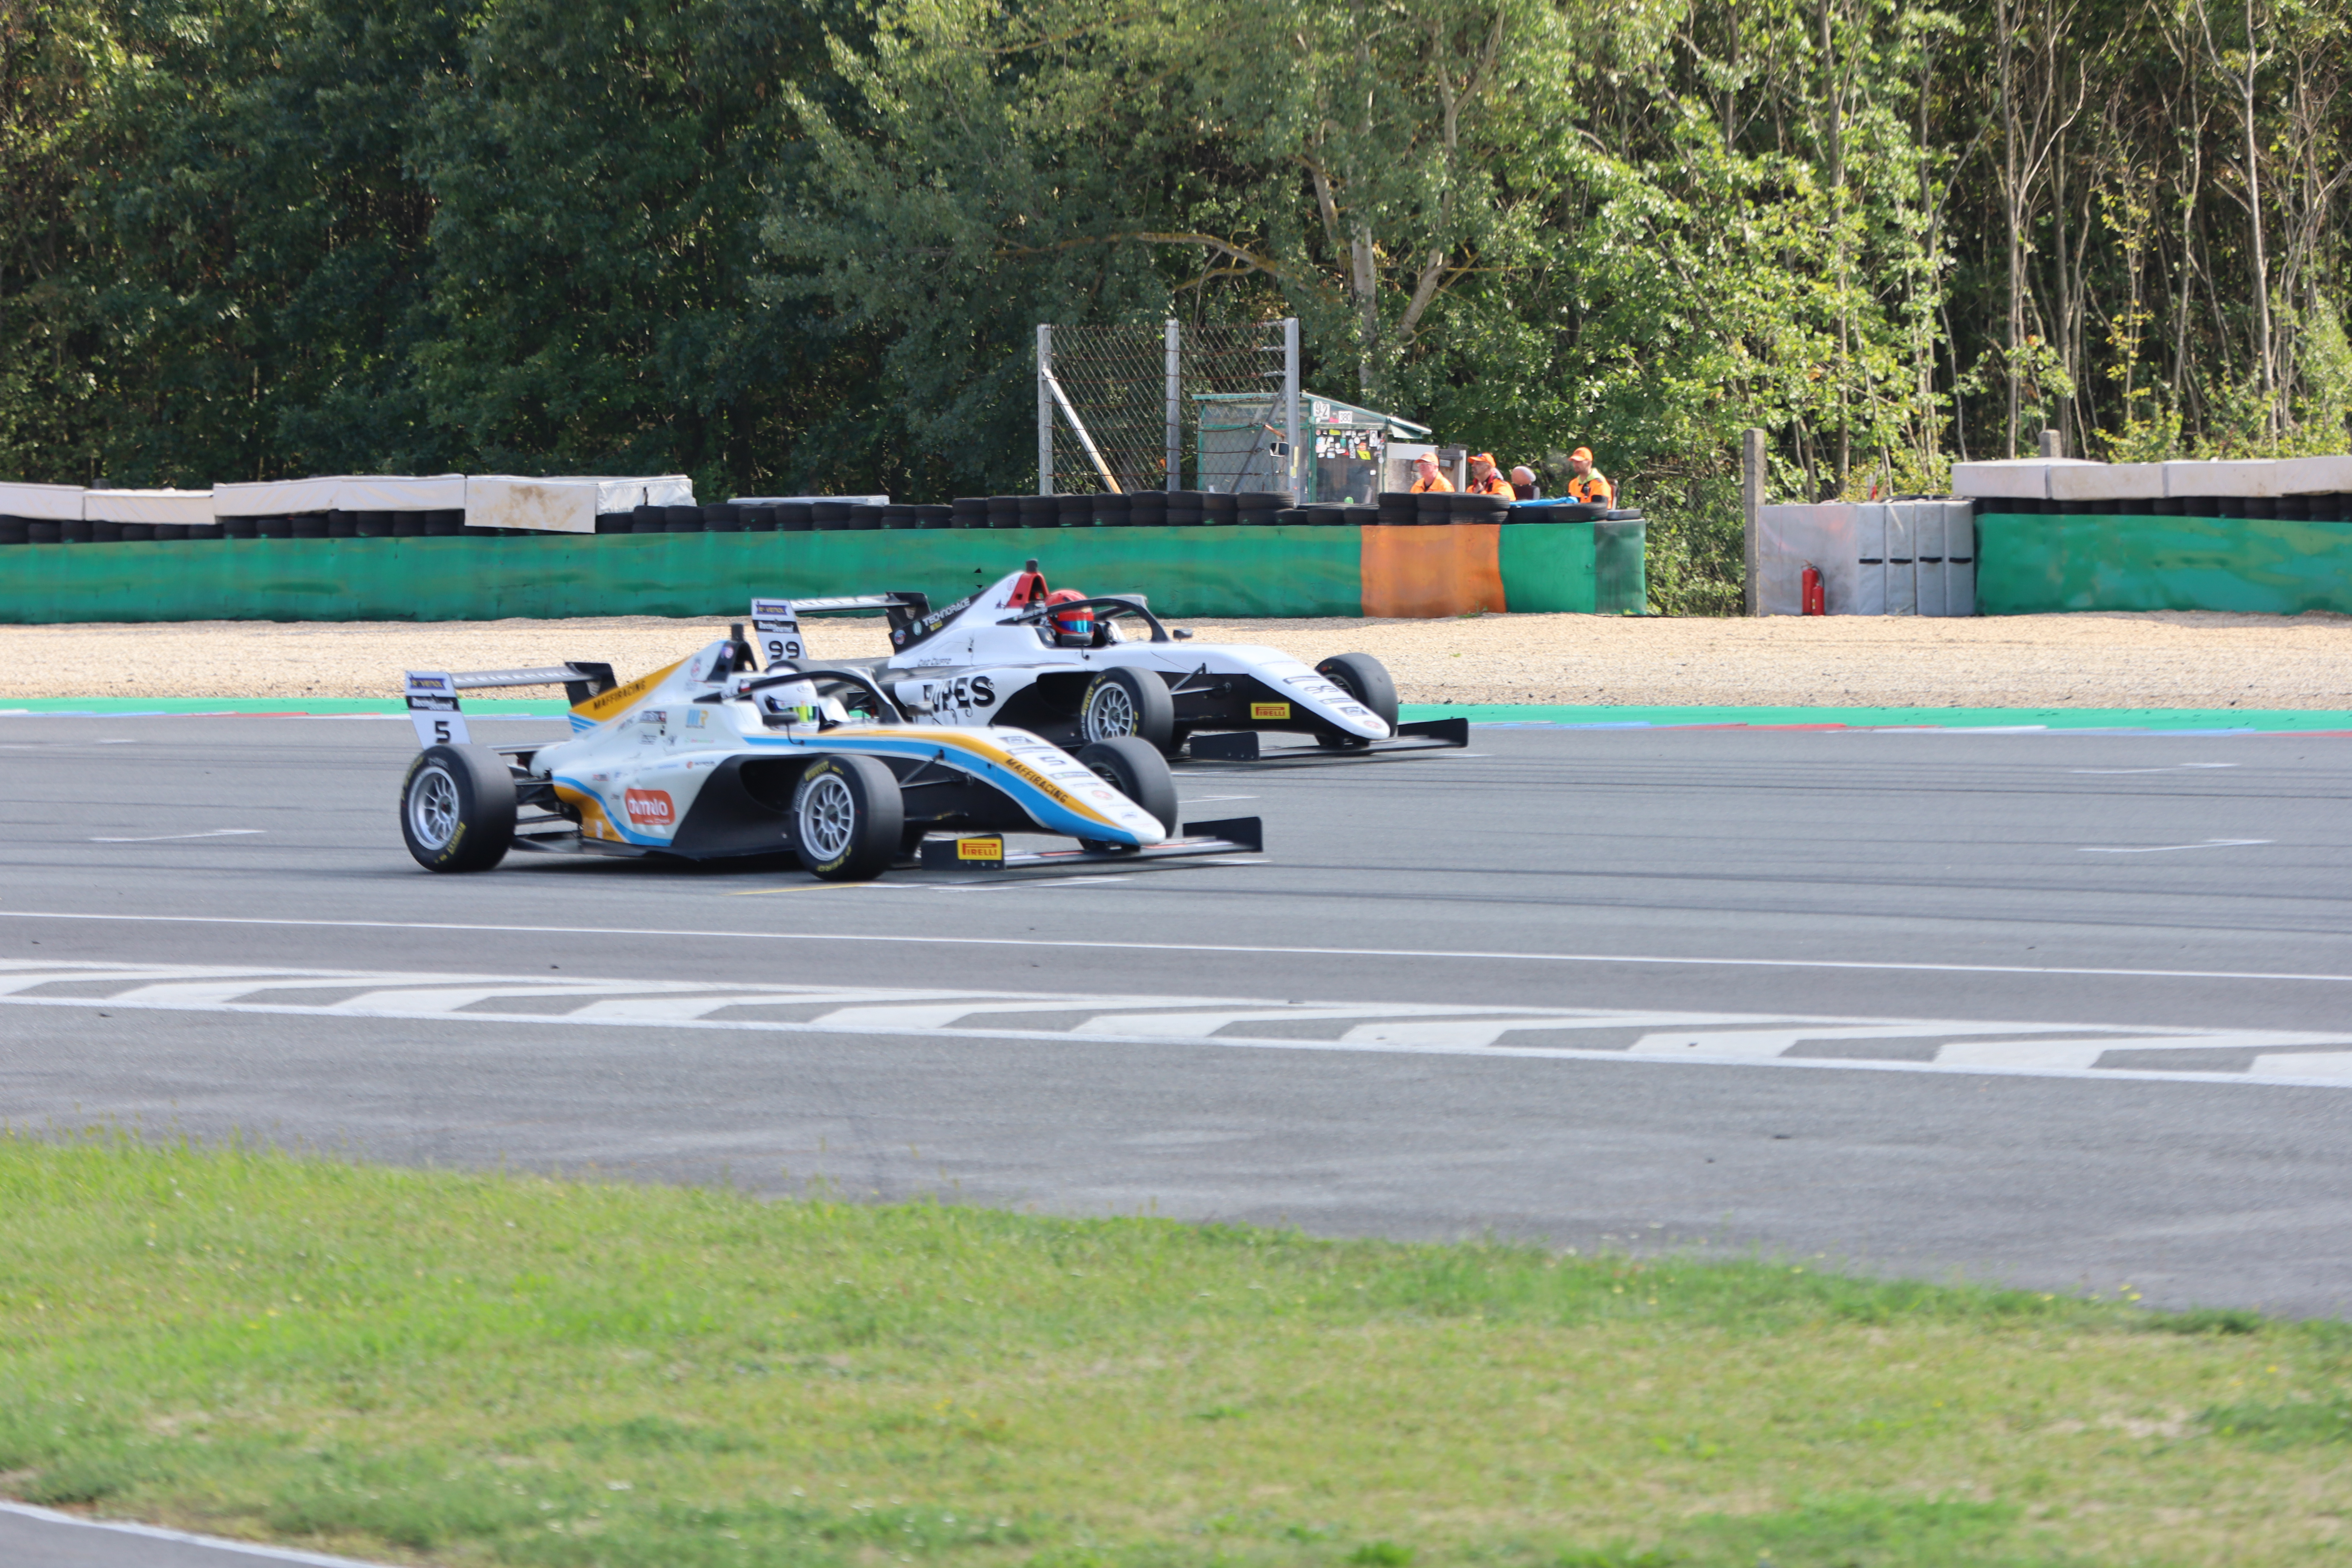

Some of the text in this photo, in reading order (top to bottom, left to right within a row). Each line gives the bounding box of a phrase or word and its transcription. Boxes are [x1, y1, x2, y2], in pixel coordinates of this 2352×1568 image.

[922, 597, 971, 626] TECHNORACE
[769, 640, 800, 660] 99
[593, 680, 646, 710] MAFFIRACING
[1256, 706, 1285, 716] PIRELLI
[435, 720, 451, 744] 5
[1006, 758, 1069, 804] MAFFIRACING
[962, 843, 997, 856] PIRELLI
